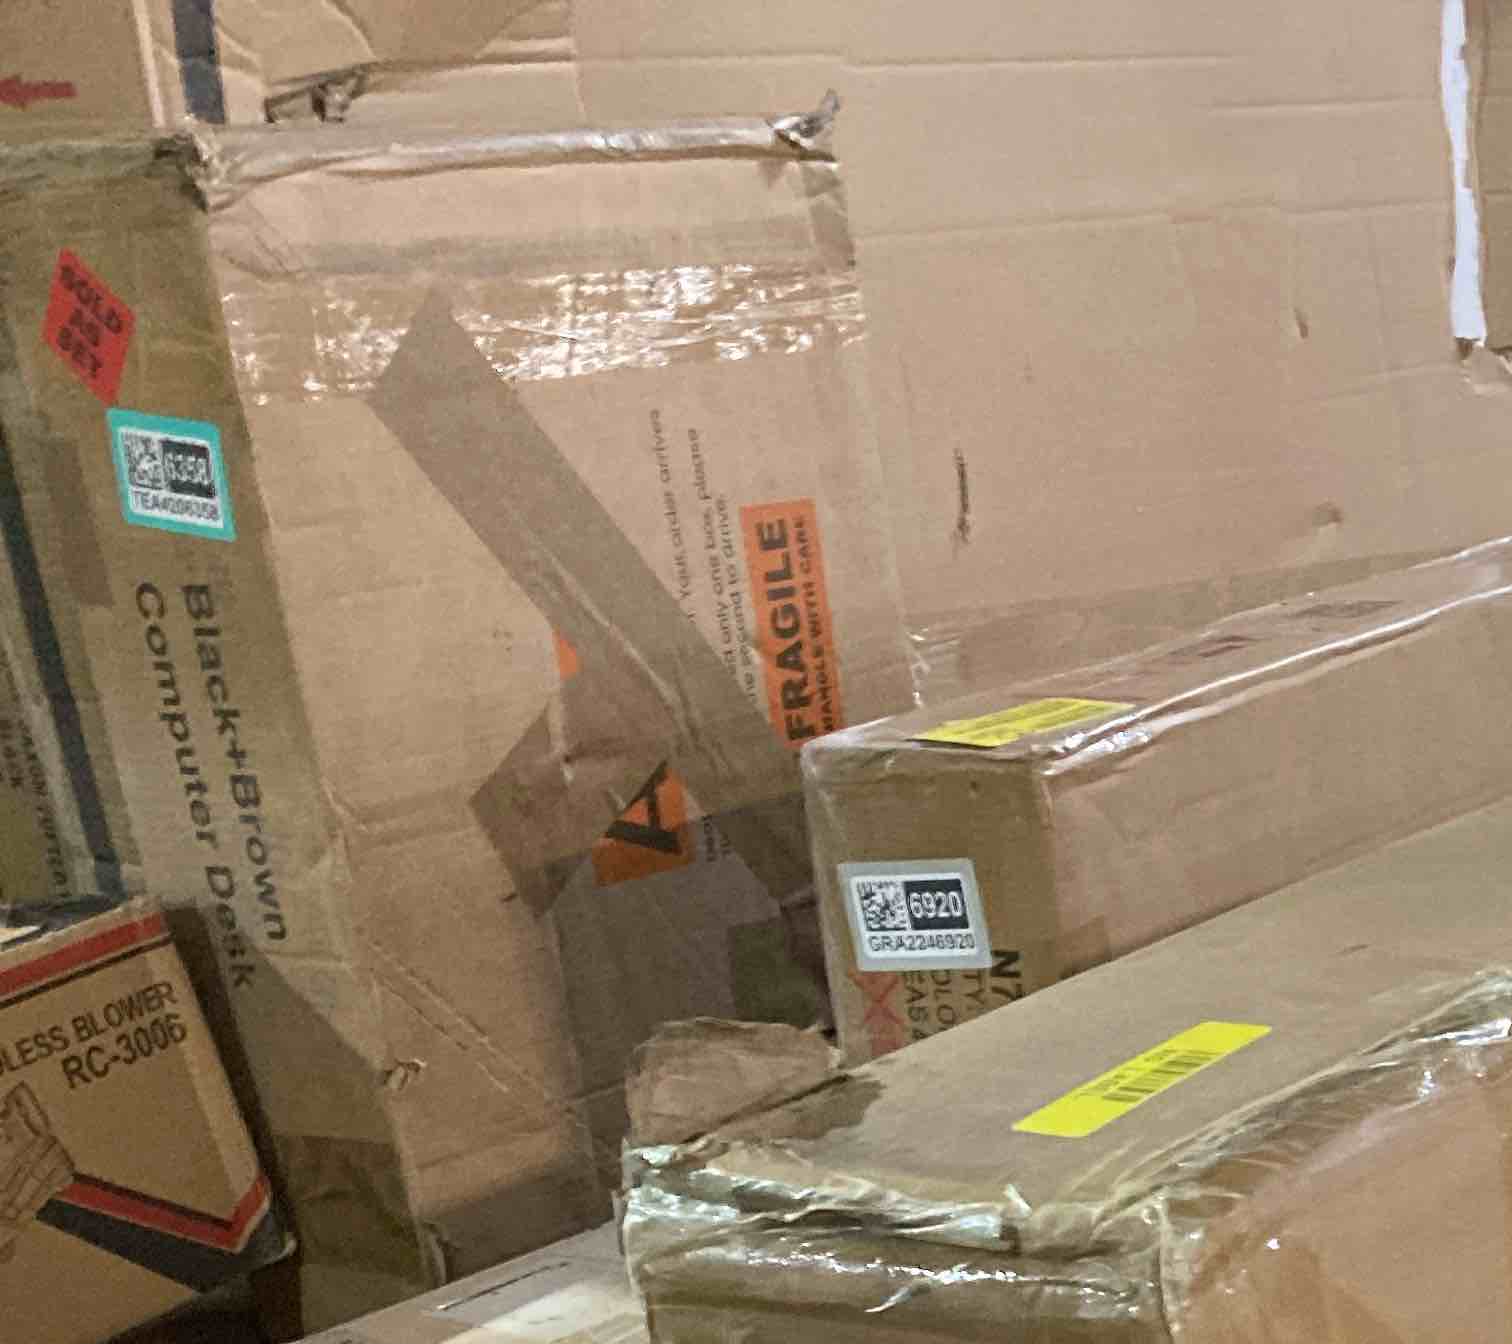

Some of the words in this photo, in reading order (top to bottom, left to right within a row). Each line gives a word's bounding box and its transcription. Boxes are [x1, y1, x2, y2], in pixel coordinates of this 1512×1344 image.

[648, 408, 671, 484] arrives
[686, 428, 711, 502] please
[661, 490, 685, 547] order
[707, 555, 725, 596] one
[723, 563, 741, 585] to
[715, 600, 736, 645] only
[756, 518, 816, 742] FRAGILE
[801, 581, 824, 639] WITH
[135, 582, 220, 851] Computer
[204, 865, 257, 989] Desk
[181, 584, 288, 942] Black+Brown
[907, 888, 964, 920] 6920
[867, 933, 976, 952] GRA2246920
[71, 980, 178, 1043] BLOWER
[61, 1012, 188, 1089] RC-3006
